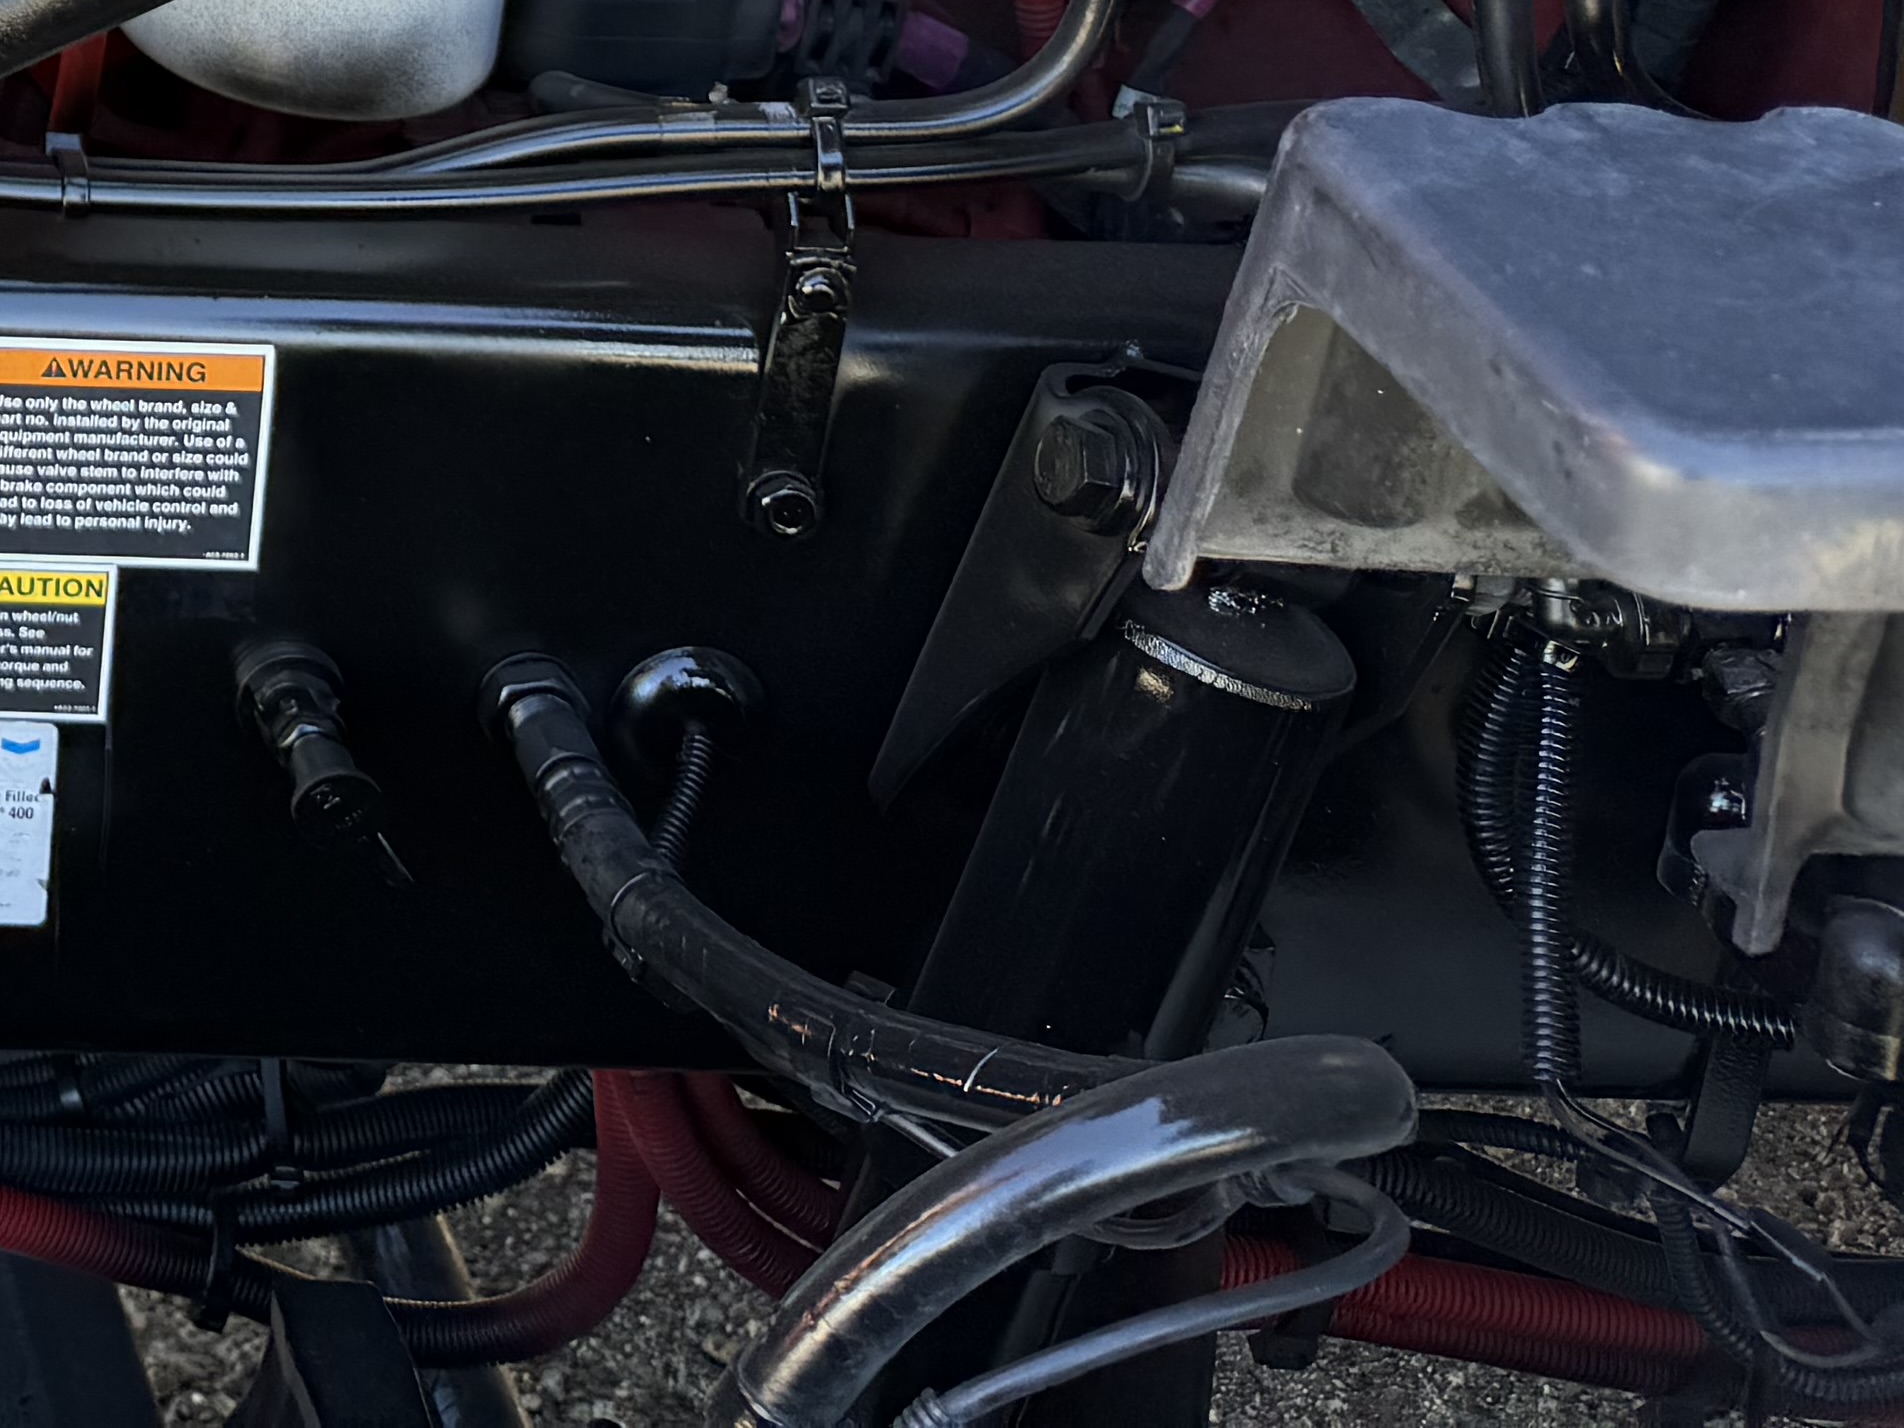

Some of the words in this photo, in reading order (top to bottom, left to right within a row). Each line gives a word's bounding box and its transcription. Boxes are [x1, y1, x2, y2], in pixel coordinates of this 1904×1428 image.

[68, 358, 207, 383] WARNING
[25, 396, 58, 412] only
[63, 396, 87, 411] the
[90, 397, 135, 412] wheel
[138, 399, 187, 415] brand,
[191, 400, 221, 414] size
[225, 402, 237, 415] &
[25, 414, 49, 426] no.
[53, 413, 118, 428] installed
[122, 415, 140, 431] by
[144, 415, 169, 430] the
[172, 416, 230, 434] original
[73, 431, 179, 446] manufacturer.
[183, 434, 214, 448] Use
[216, 435, 232, 448] of
[235, 437, 246, 449] a
[56, 448, 101, 462] wheel
[104, 448, 148, 463] brand
[152, 452, 169, 464] or
[172, 451, 203, 464] size
[206, 451, 249, 466] could
[37, 464, 77, 477] valve
[80, 465, 118, 478] stem
[121, 465, 137, 478] to
[140, 466, 204, 481] interfere
[207, 468, 239, 482] with
[0, 478, 42, 492] brake
[46, 481, 131, 496] component
[134, 482, 180, 496] which
[183, 484, 226, 498] could
[22, 496, 37, 509] to
[41, 496, 73, 510] loss
[76, 496, 93, 510] of
[96, 498, 149, 512] vehicle
[152, 499, 206, 514] control
[209, 501, 238, 515] and
[20, 513, 52, 527] lead
[56, 514, 71, 527] to
[75, 516, 141, 530] personal
[144, 516, 192, 533] injury.
[12, 610, 79, 623] wheel/nut
[19, 626, 45, 639] See
[21, 644, 70, 656] manual
[73, 645, 93, 656] for
[43, 661, 69, 672] and
[17, 678, 86, 690] sequence.
[9, 807, 34, 819] 400
